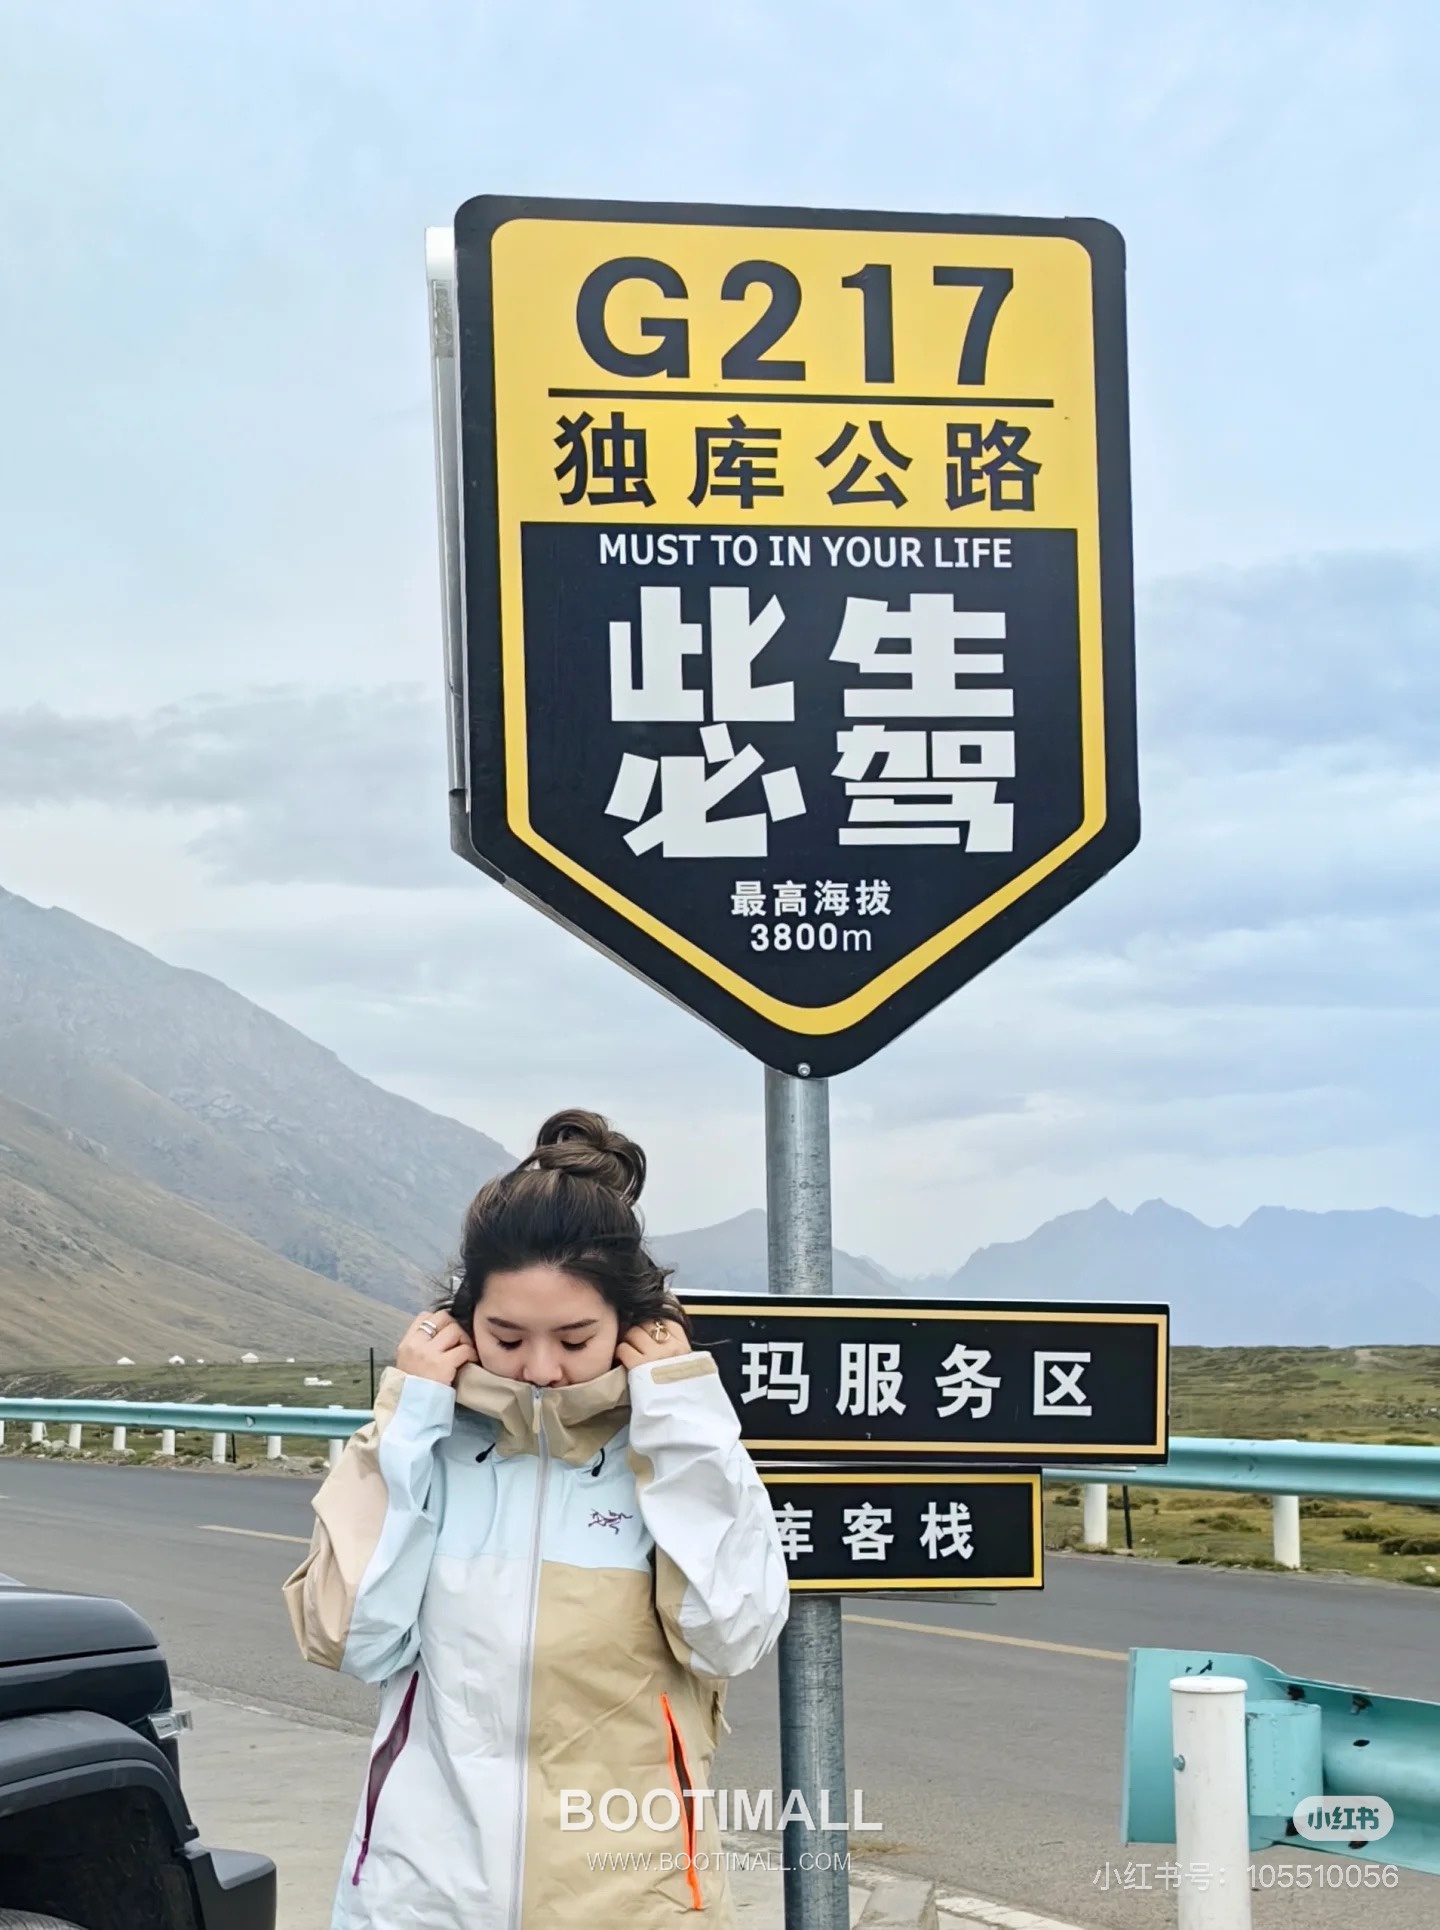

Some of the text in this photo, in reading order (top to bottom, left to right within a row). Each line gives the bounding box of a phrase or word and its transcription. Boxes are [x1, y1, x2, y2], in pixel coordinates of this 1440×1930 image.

[575, 256, 1015, 386] G217
[553, 411, 1042, 511] 独库公路
[598, 533, 1013, 568] MUST TO IN YOUR LIFE
[609, 585, 1015, 722] 此生
[604, 722, 1016, 858] 必驾
[730, 880, 892, 918] 最高海拔
[750, 923, 873, 953] 3800m
[740, 1341, 1093, 1419] 玛服务区
